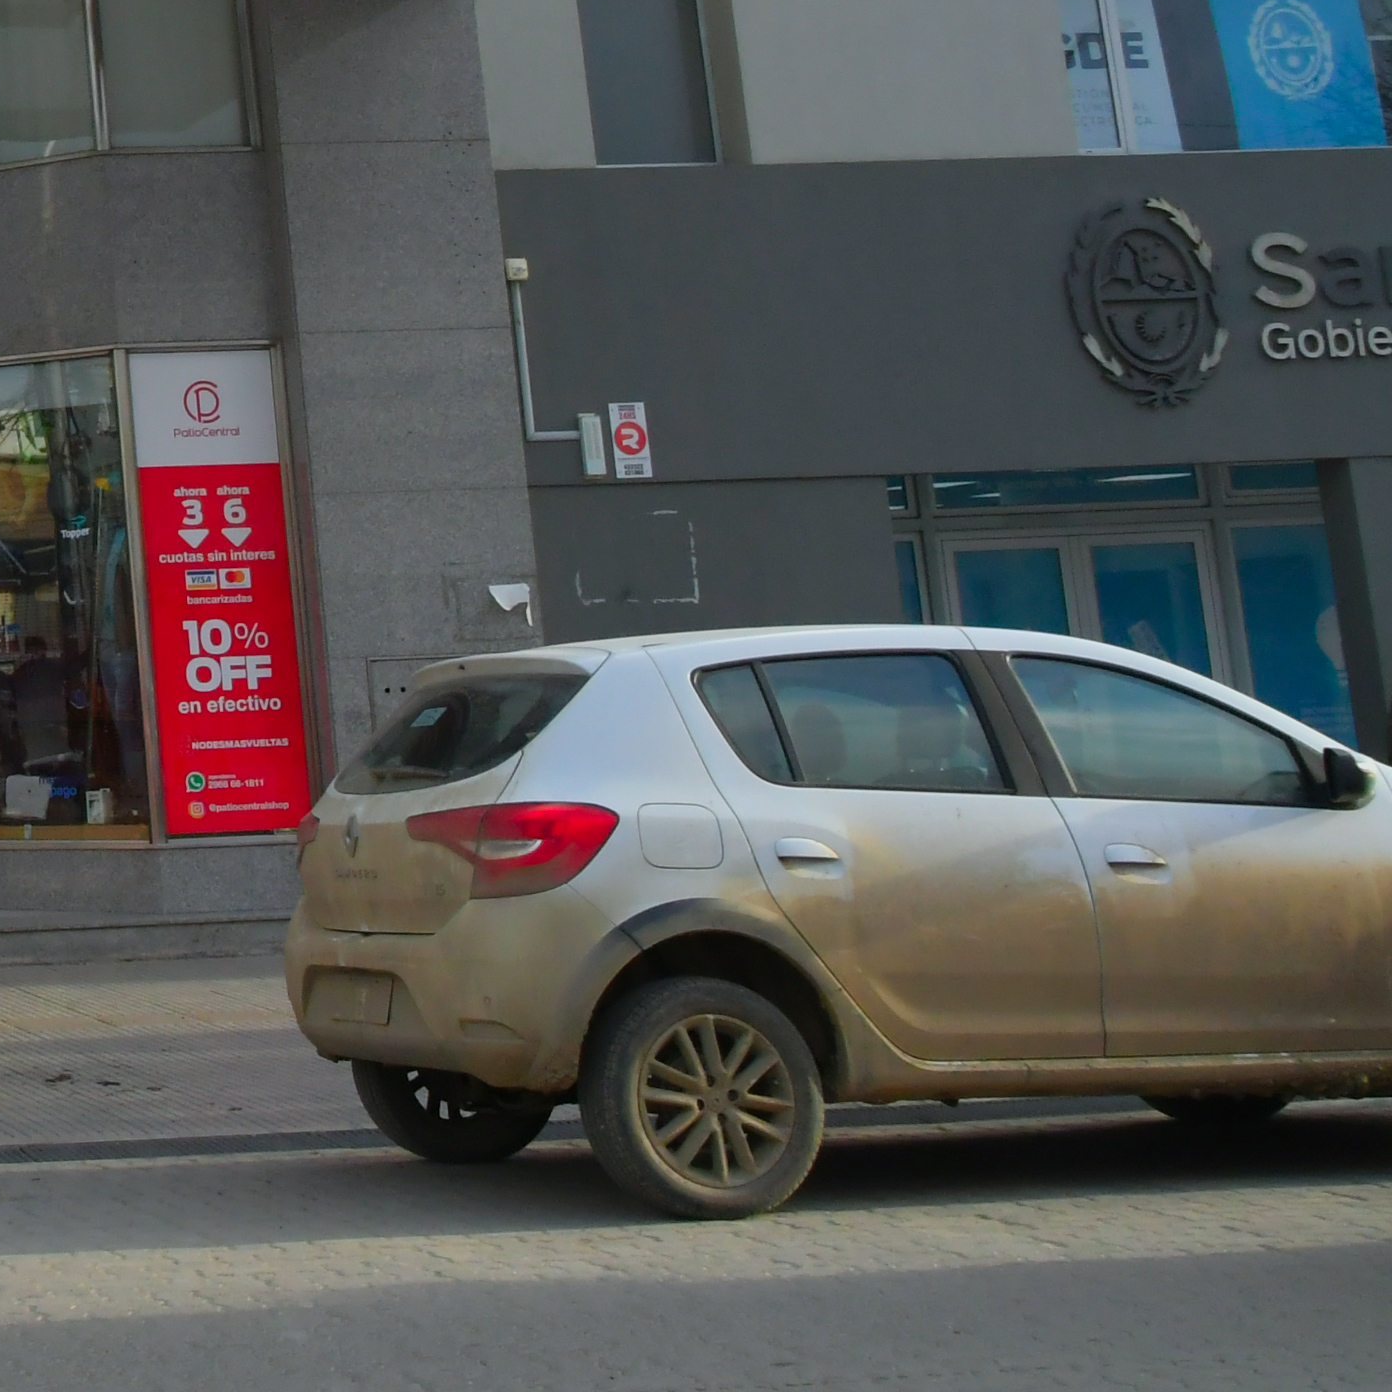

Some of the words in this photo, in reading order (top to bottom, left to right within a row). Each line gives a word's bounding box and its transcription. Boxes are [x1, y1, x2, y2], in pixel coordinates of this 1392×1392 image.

[173, 427, 240, 438] PatioCentral
[173, 486, 207, 497] ahora
[216, 485, 250, 496] ahora
[181, 499, 203, 526] 3
[223, 498, 246, 525] 6
[60, 528, 90, 539] Topper
[159, 551, 204, 564] cuotas
[207, 550, 227, 562] sin
[230, 549, 276, 561] interes
[191, 575, 212, 584] VISA
[186, 594, 253, 605] bancarizadas
[182, 619, 269, 655] 10%
[186, 655, 272, 692] OFF
[178, 701, 202, 714] en
[207, 695, 281, 712] efectivo
[192, 738, 289, 750] NODESMASVUELTAS
[208, 801, 289, 813] @patiocentralshop
